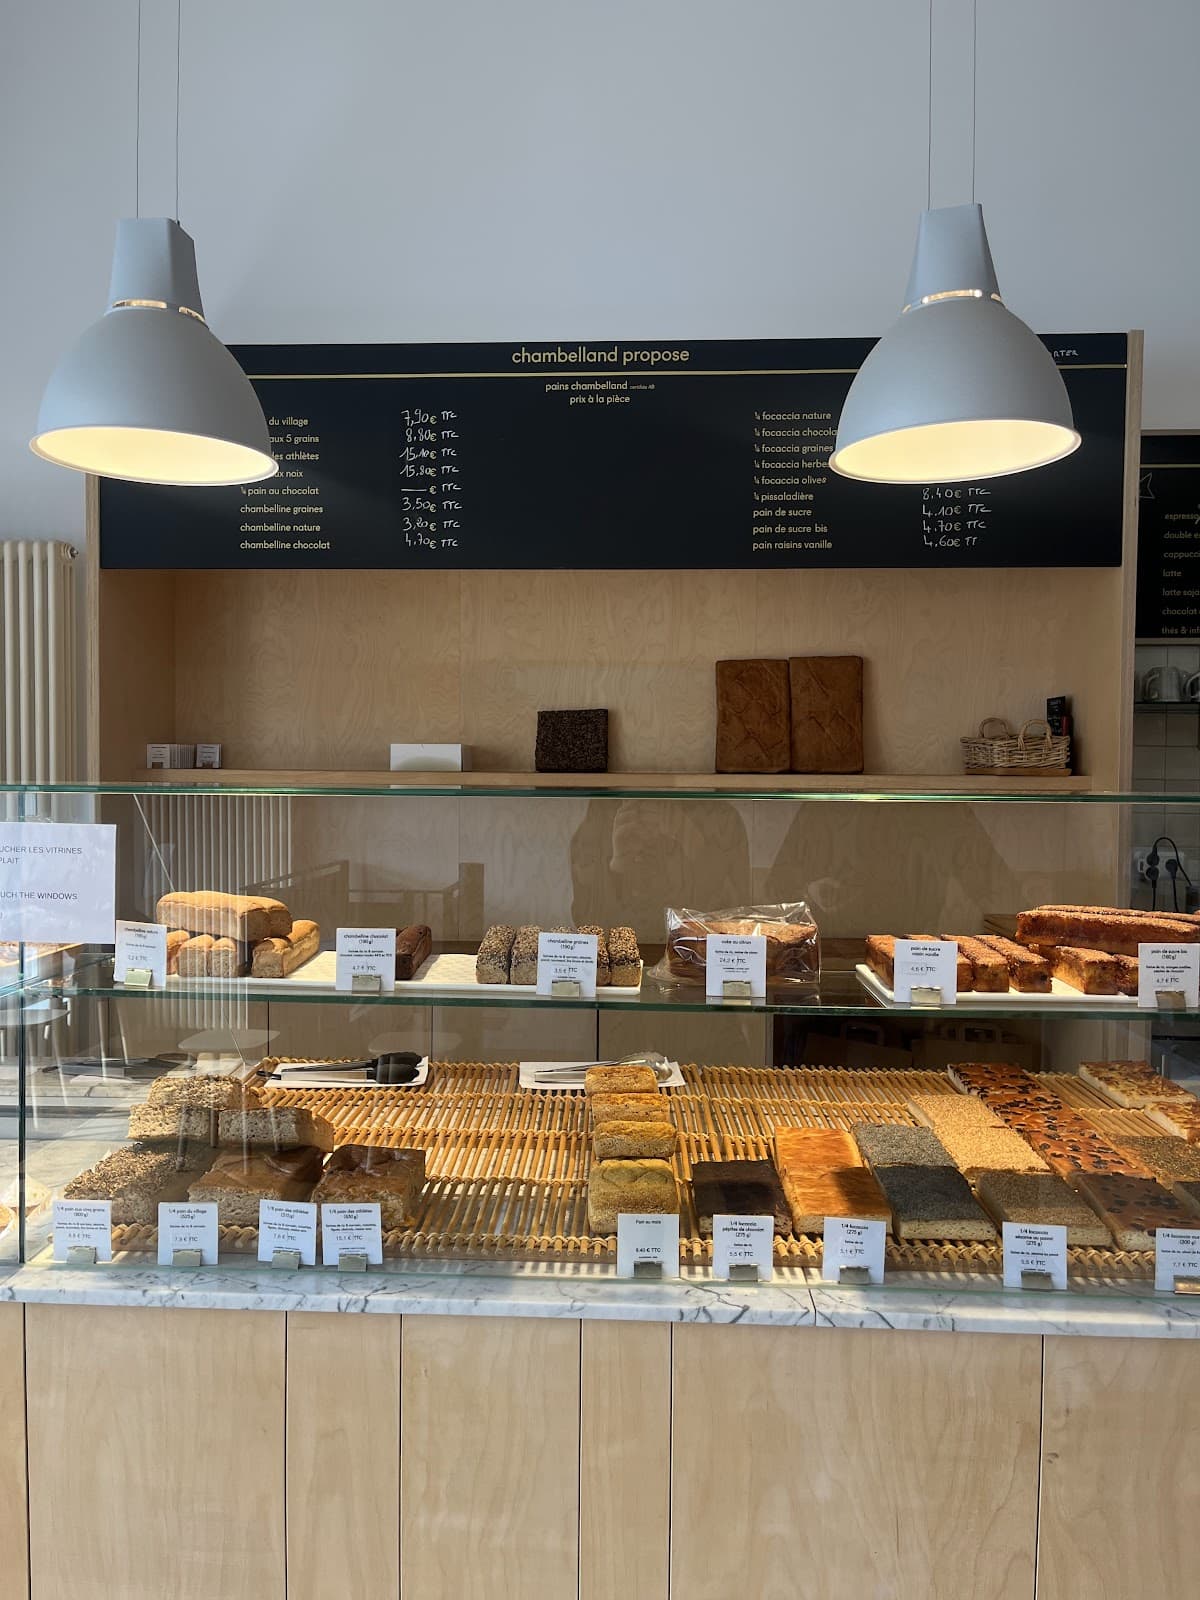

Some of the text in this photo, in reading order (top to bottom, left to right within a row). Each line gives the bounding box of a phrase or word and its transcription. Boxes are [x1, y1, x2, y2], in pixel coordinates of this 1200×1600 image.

[512, 346, 690, 366] chambelland propose
[546, 382, 569, 392] pains
[570, 380, 628, 390] chambelland
[570, 394, 630, 406] prix à la pièce
[441, 410, 457, 420] TTC
[762, 411, 800, 420] focaccia
[268, 416, 308, 428] du village
[441, 430, 460, 440] TTC
[762, 428, 800, 436] focaccia
[802, 427, 838, 436] chocola
[286, 434, 292, 442] 5
[294, 434, 320, 444] grains
[441, 448, 457, 457] TTC
[762, 444, 800, 452] focaccia
[802, 444, 834, 454] graines
[285, 451, 320, 460] athlètes
[761, 460, 800, 468] focaccia
[286, 469, 304, 478] noix
[441, 466, 460, 474] TTC
[761, 476, 799, 485] focaccia
[801, 476, 827, 484] olives
[248, 486, 266, 496] pain
[282, 486, 319, 495] chocolat
[442, 483, 462, 492] TTC
[968, 487, 991, 496] TTC
[761, 492, 814, 503] pissaladière
[240, 504, 324, 515] chambelline graines
[442, 500, 463, 510] TTC
[968, 503, 992, 514] TTC
[753, 508, 772, 518] pain
[774, 507, 786, 516] de
[240, 522, 291, 532] chambelline
[443, 520, 461, 528] TTC
[966, 520, 987, 529] TTC
[753, 525, 772, 535] pain
[774, 524, 786, 533] de
[814, 524, 828, 532] bis
[1164, 530, 1192, 538] double
[240, 540, 330, 549] chambelline chocolat
[441, 539, 458, 547] TTC
[753, 540, 833, 551] pain raisins vanille
[1162, 588, 1182, 596] latte
